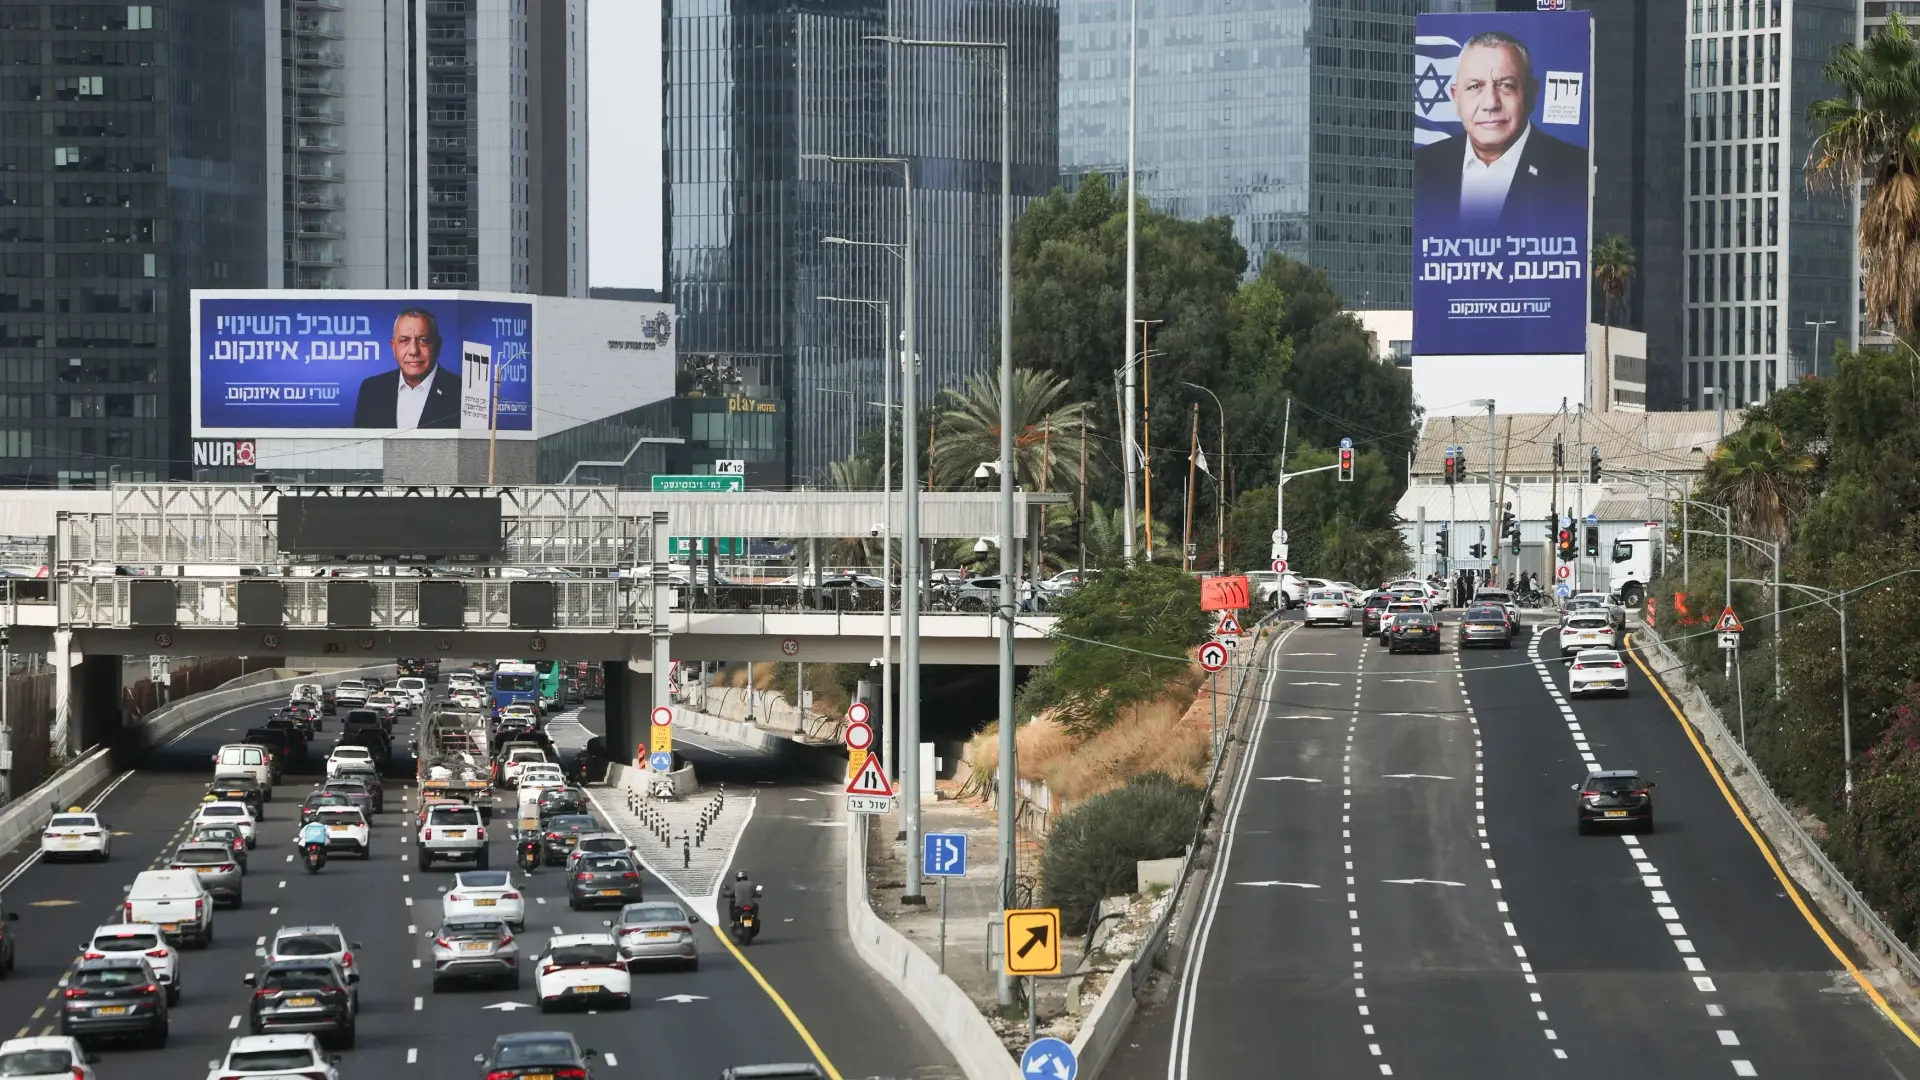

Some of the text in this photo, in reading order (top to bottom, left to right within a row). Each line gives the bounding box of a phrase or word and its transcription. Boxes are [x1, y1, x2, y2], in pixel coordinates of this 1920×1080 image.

[1548, 78, 1580, 101] דרך
[1422, 235, 1578, 257] בשביל ישראל!
[1418, 260, 1581, 284] הפעם, איזנקוט.
[1448, 301, 1551, 316] ישר! עם איזנקוט.
[216, 313, 371, 336] בשביל השינוי!
[491, 317, 527, 339] יש דרך
[209, 340, 380, 364] הפעם, איזנקוט.
[502, 341, 527, 360] אחת
[464, 351, 489, 389] דרך
[224, 387, 340, 402] ישר! עם איזנקוט.
[728, 393, 777, 415] play HOTEL
[194, 441, 235, 466] NUR
[733, 464, 743, 473] 12
[851, 799, 887, 810] שול צר
